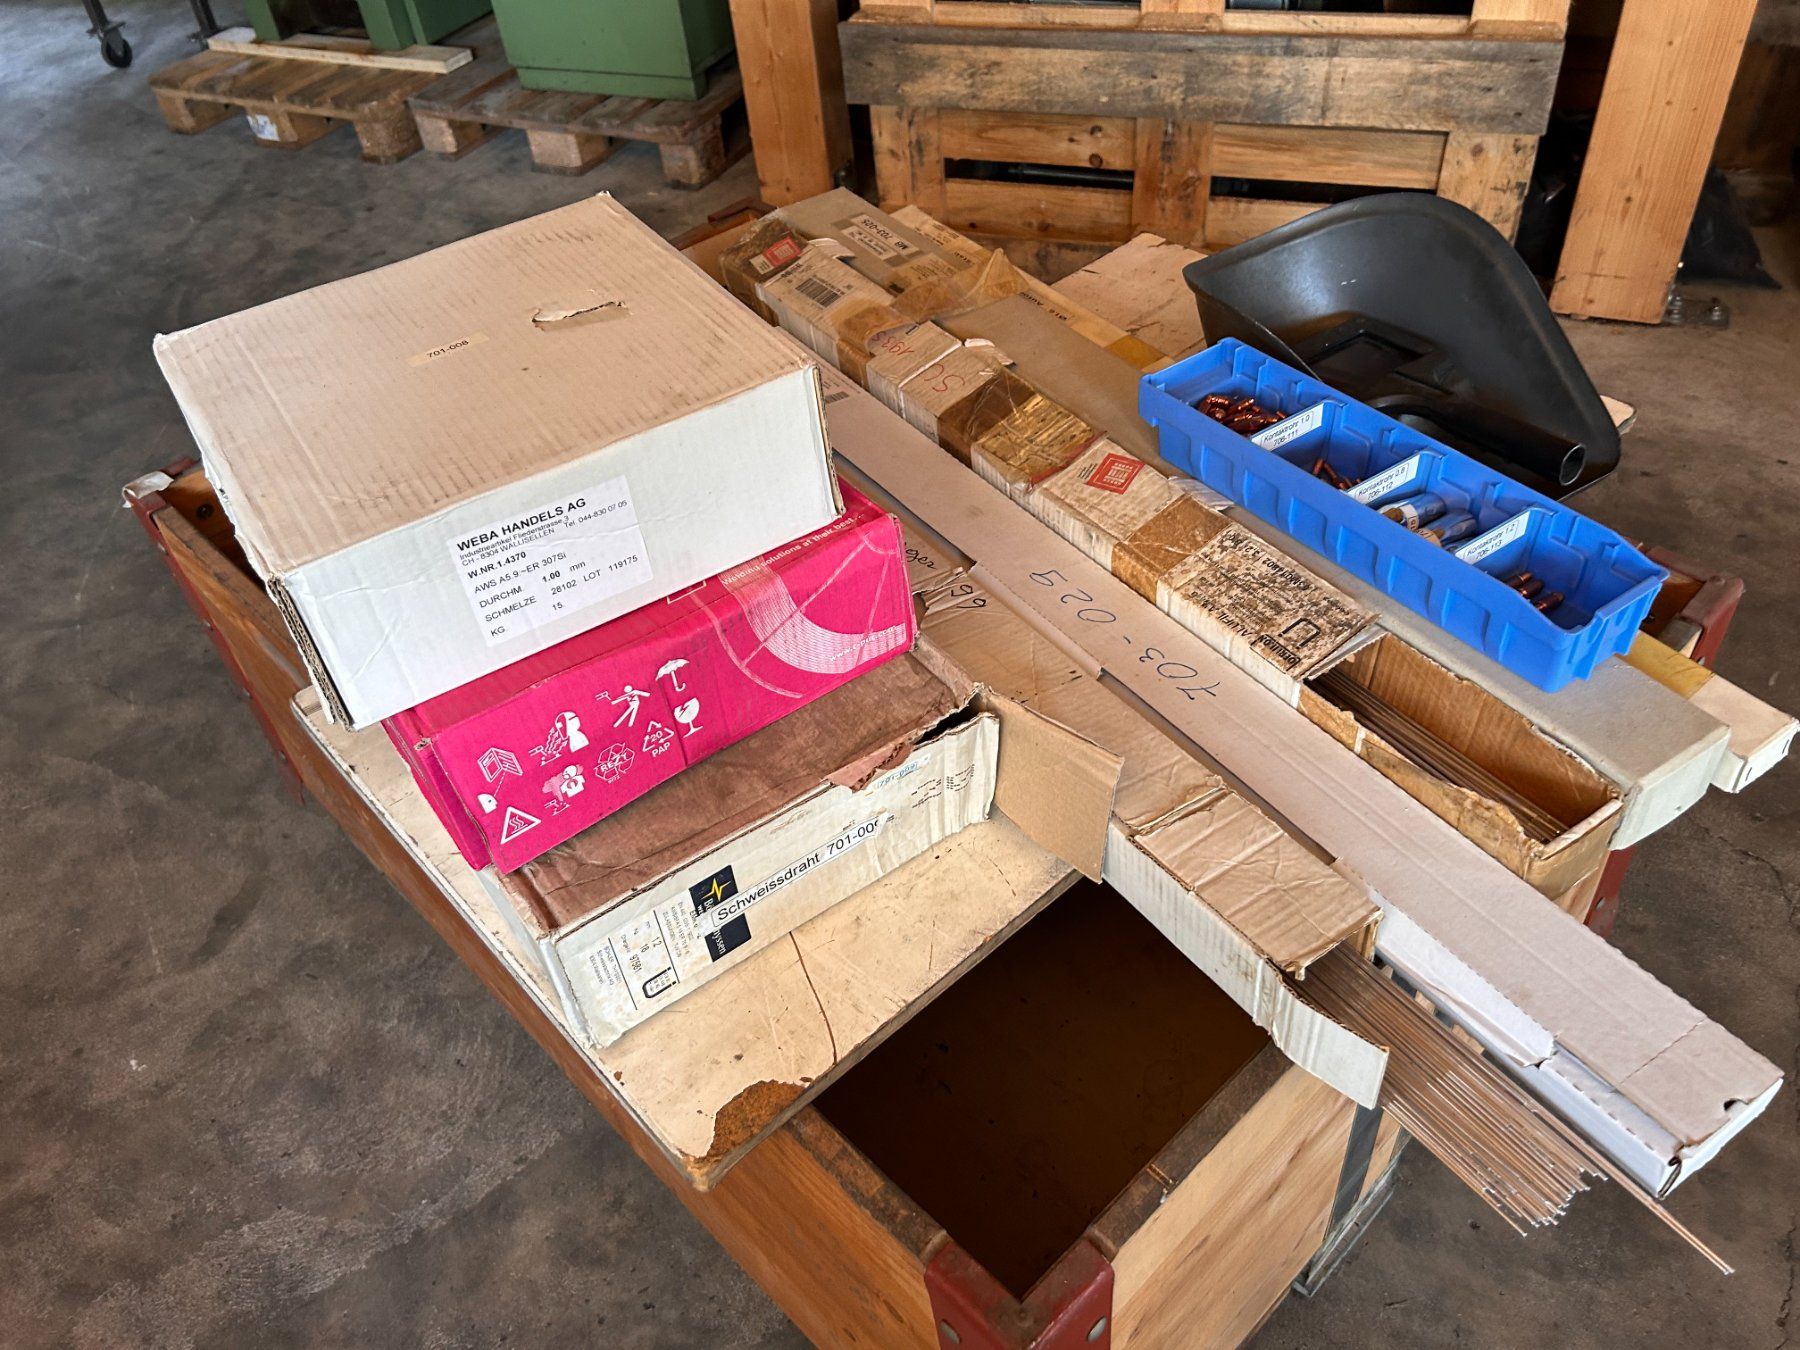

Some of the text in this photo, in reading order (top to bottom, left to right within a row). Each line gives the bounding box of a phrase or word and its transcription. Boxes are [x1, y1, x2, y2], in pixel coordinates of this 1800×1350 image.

[1264, 421, 1298, 443] Kontaktrohr
[456, 498, 586, 551] WEBA HANDELS AG
[462, 558, 475, 566] CH
[480, 549, 499, 560] 8304
[500, 528, 555, 552] WALLISELLEN
[578, 508, 607, 522] 044-830
[760, 544, 801, 567] solutions
[803, 539, 812, 548] at
[813, 528, 832, 542] their
[474, 579, 497, 594] AWS
[542, 570, 560, 582] 1.00
[570, 561, 586, 572] mm
[485, 554, 638, 622] SCHMELZE 28102 LOT 119175
[650, 730, 662, 742] 20
[652, 742, 670, 757] PAP
[718, 852, 820, 920] Schweissdraht
